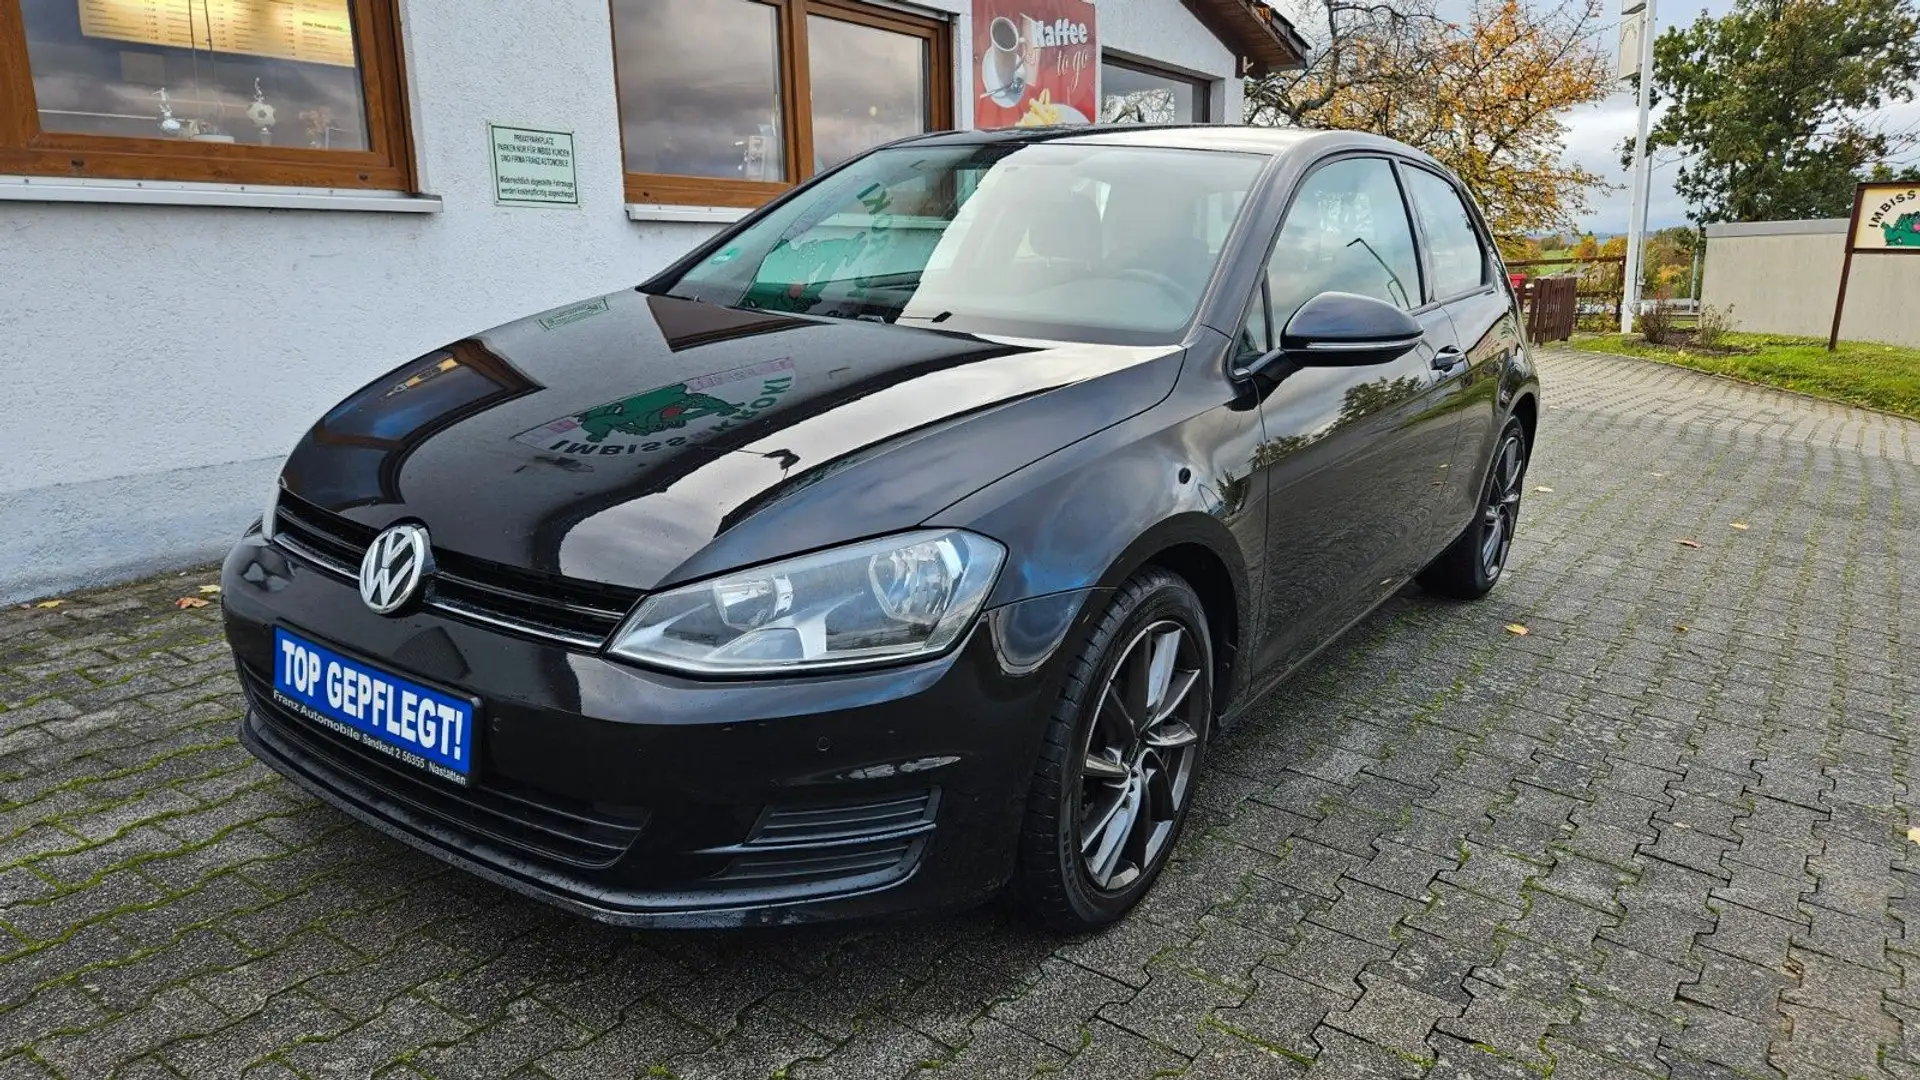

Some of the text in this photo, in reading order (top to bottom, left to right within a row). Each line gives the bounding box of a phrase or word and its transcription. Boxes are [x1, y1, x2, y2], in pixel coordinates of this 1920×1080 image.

[1031, 18, 1088, 48] Kaffee
[1057, 49, 1090, 93] to go
[497, 143, 516, 152] PARKEN
[517, 145, 526, 153] NUR
[1868, 189, 1917, 228] IMBISS
[281, 639, 464, 761] TOP GEPFLEGT!
[273, 688, 300, 712] Franz
[299, 705, 360, 742] Automobile
[395, 747, 401, 760] 2
[402, 752, 425, 770] 56355
